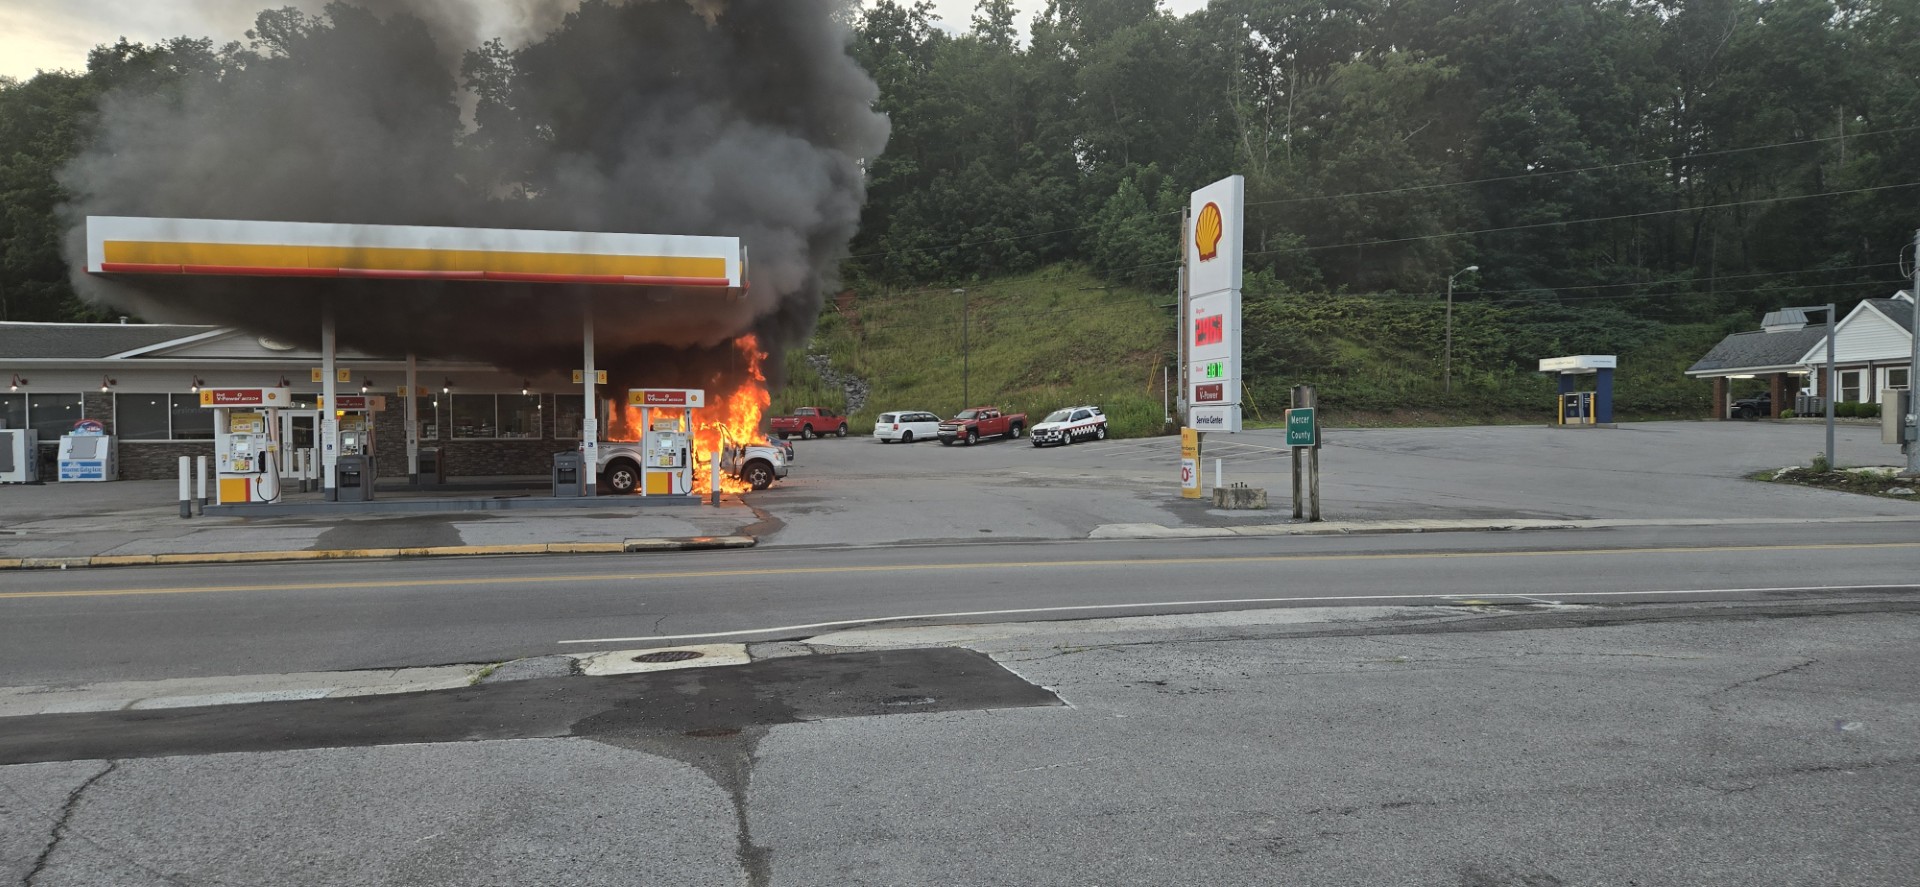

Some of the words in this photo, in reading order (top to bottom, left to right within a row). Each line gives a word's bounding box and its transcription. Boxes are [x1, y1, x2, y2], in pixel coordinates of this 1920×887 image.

[1199, 391, 1218, 400] V-Power
[1196, 415, 1209, 425] Service
[1210, 414, 1223, 424] Center
[1291, 415, 1310, 425] Mercer
[1291, 430, 1311, 441] County
